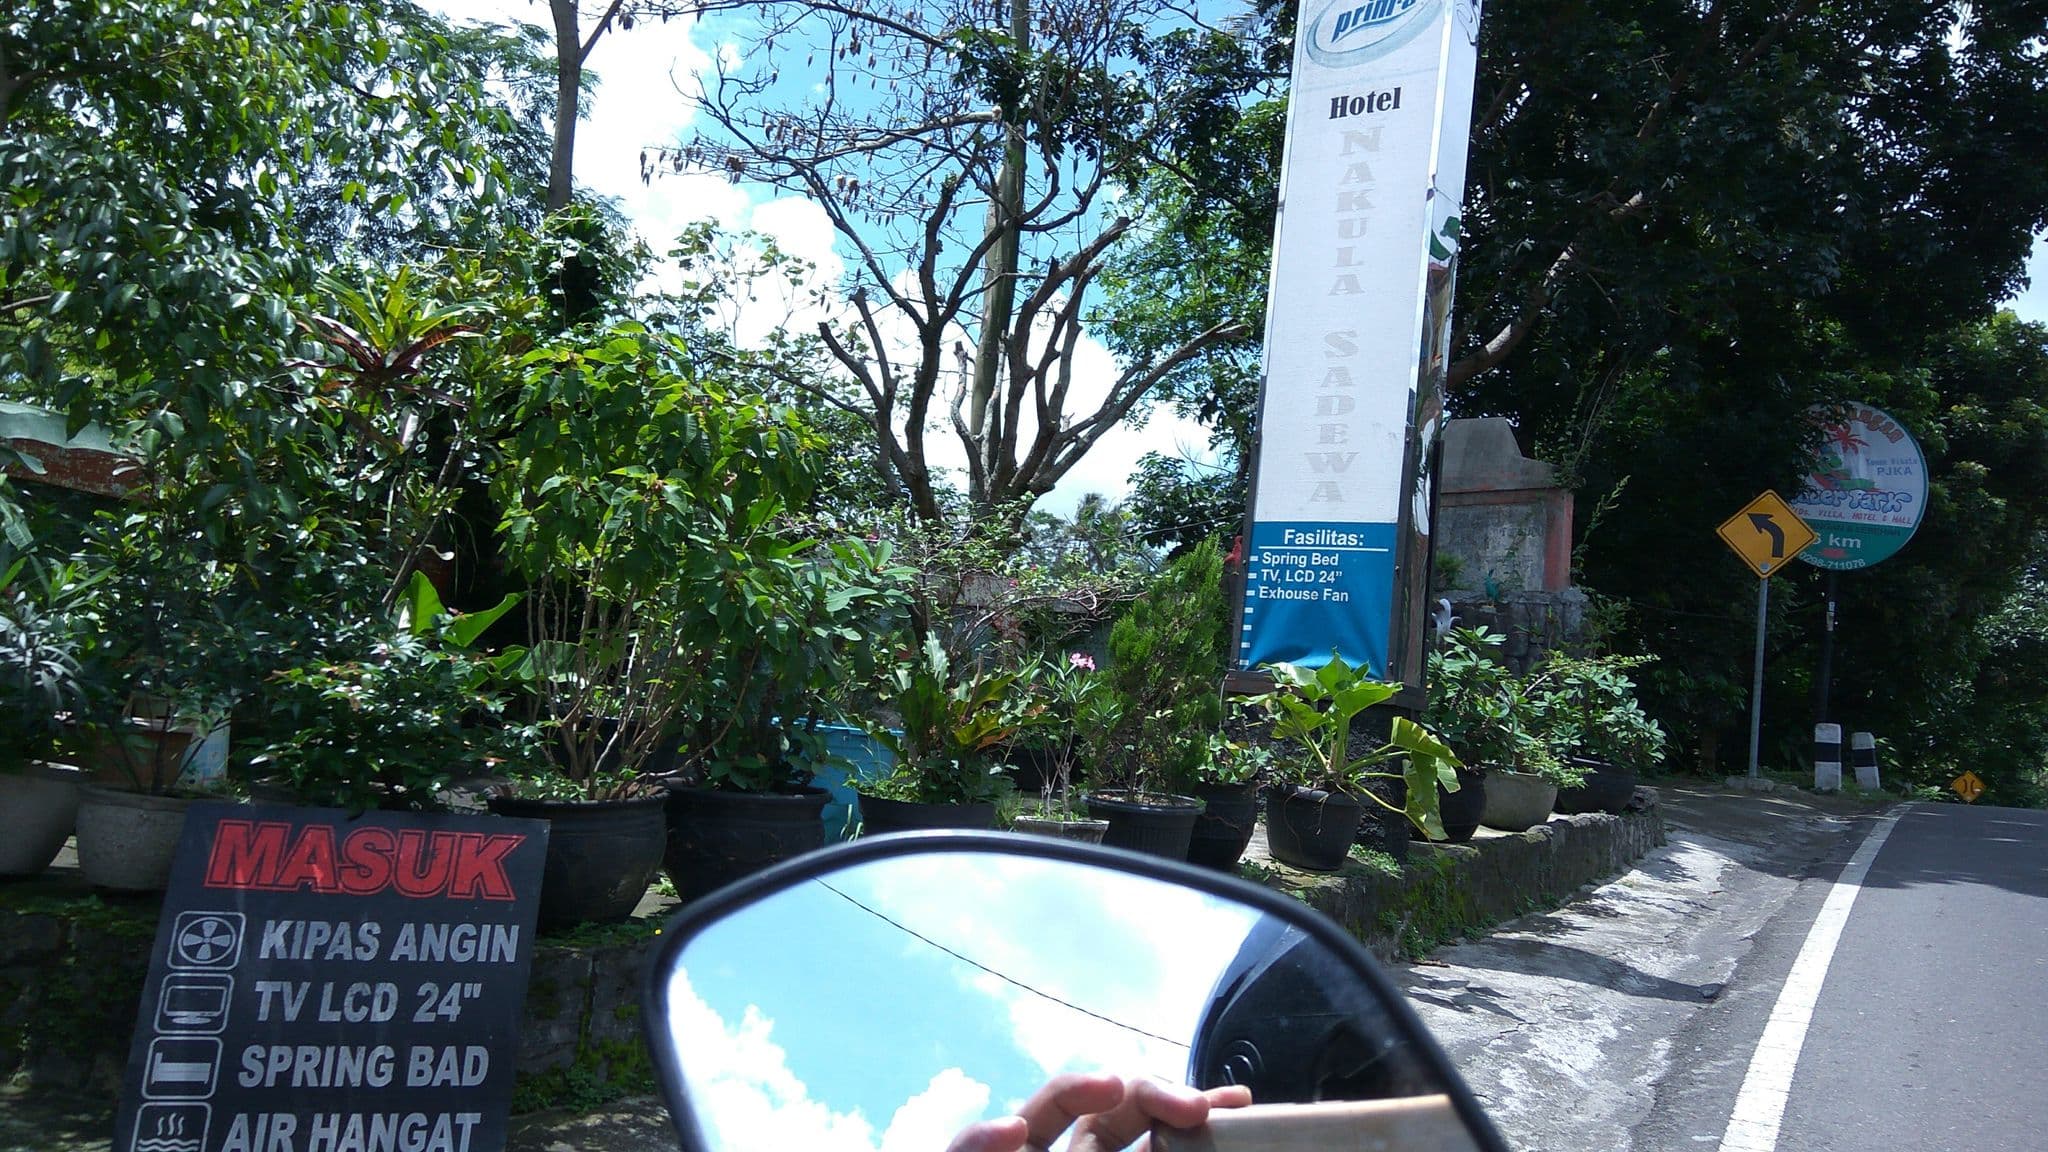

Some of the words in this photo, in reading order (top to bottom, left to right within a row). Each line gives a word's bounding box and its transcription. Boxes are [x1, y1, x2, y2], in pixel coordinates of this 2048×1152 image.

[1329, 87, 1402, 119] Hotel
[1327, 126, 1386, 296] NAKULA
[1304, 330, 1360, 502] SADEWA
[1877, 466, 1912, 476] PJKA
[1848, 489, 1913, 513] Park
[1284, 529, 1364, 546] Fasilitas:
[1829, 533, 1861, 548] km
[1262, 552, 1307, 567] Spring
[1311, 552, 1339, 566] Bed
[1261, 569, 1281, 583] TV,
[1285, 571, 1315, 582] LCD
[1258, 586, 1319, 600] Exhouse
[1323, 588, 1349, 602] Fan
[204, 819, 527, 900] MASUK
[258, 920, 381, 961] KIPAS
[390, 922, 520, 963] ANGIN
[254, 980, 311, 1021] TV
[318, 981, 399, 1022] LCD
[238, 1044, 396, 1087] SPRING
[407, 1045, 490, 1087] BAD
[220, 1111, 297, 1152] AIR
[308, 1111, 481, 1152] HANGAT
